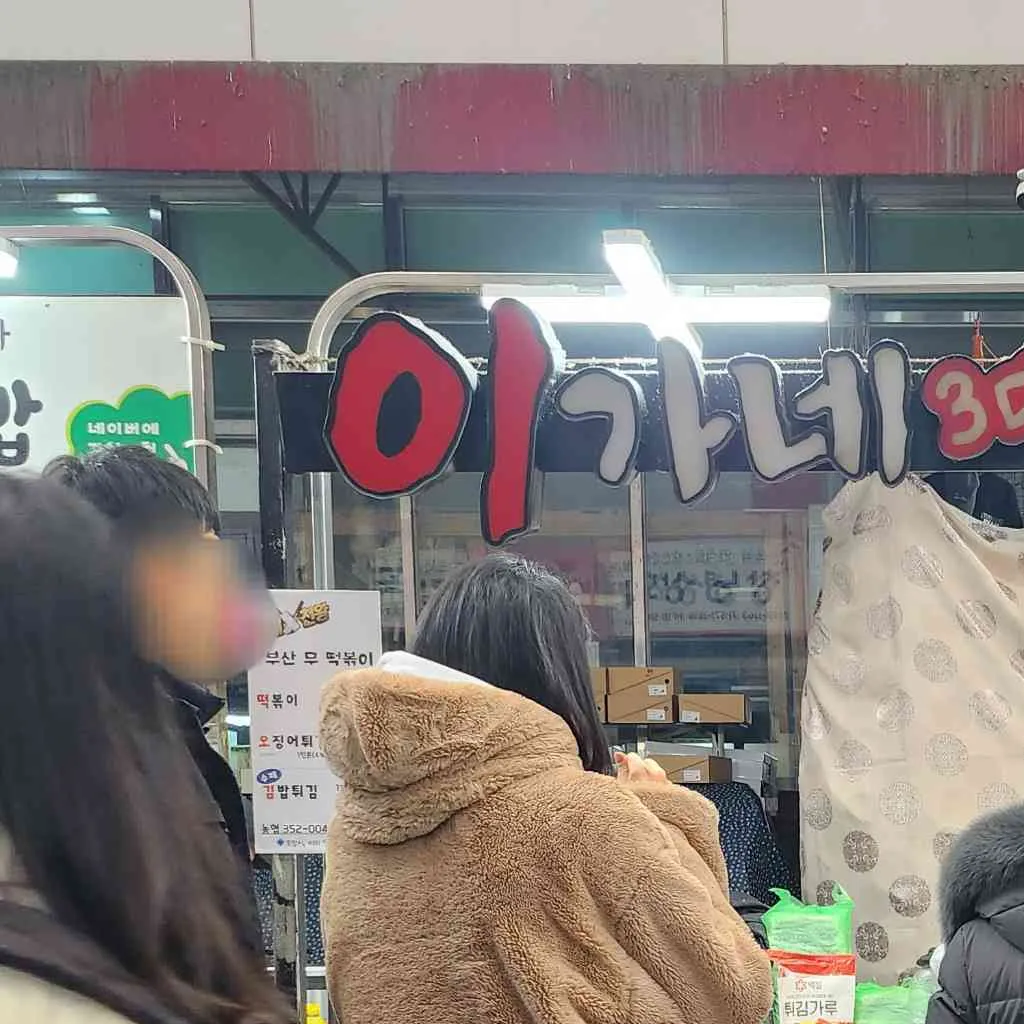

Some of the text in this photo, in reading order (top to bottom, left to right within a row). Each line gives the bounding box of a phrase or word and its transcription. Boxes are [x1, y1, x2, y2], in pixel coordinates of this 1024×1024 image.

[87, 421, 160, 435] 네이버에
[324, 298, 916, 546] 이가네
[265, 651, 374, 667] 부산 무 떡볶이
[256, 694, 298, 708] 떡볶이
[258, 735, 317, 750] 오징어튀
[263, 784, 318, 800] 김밥튀김
[784, 1000, 838, 1017] 튀김가루
